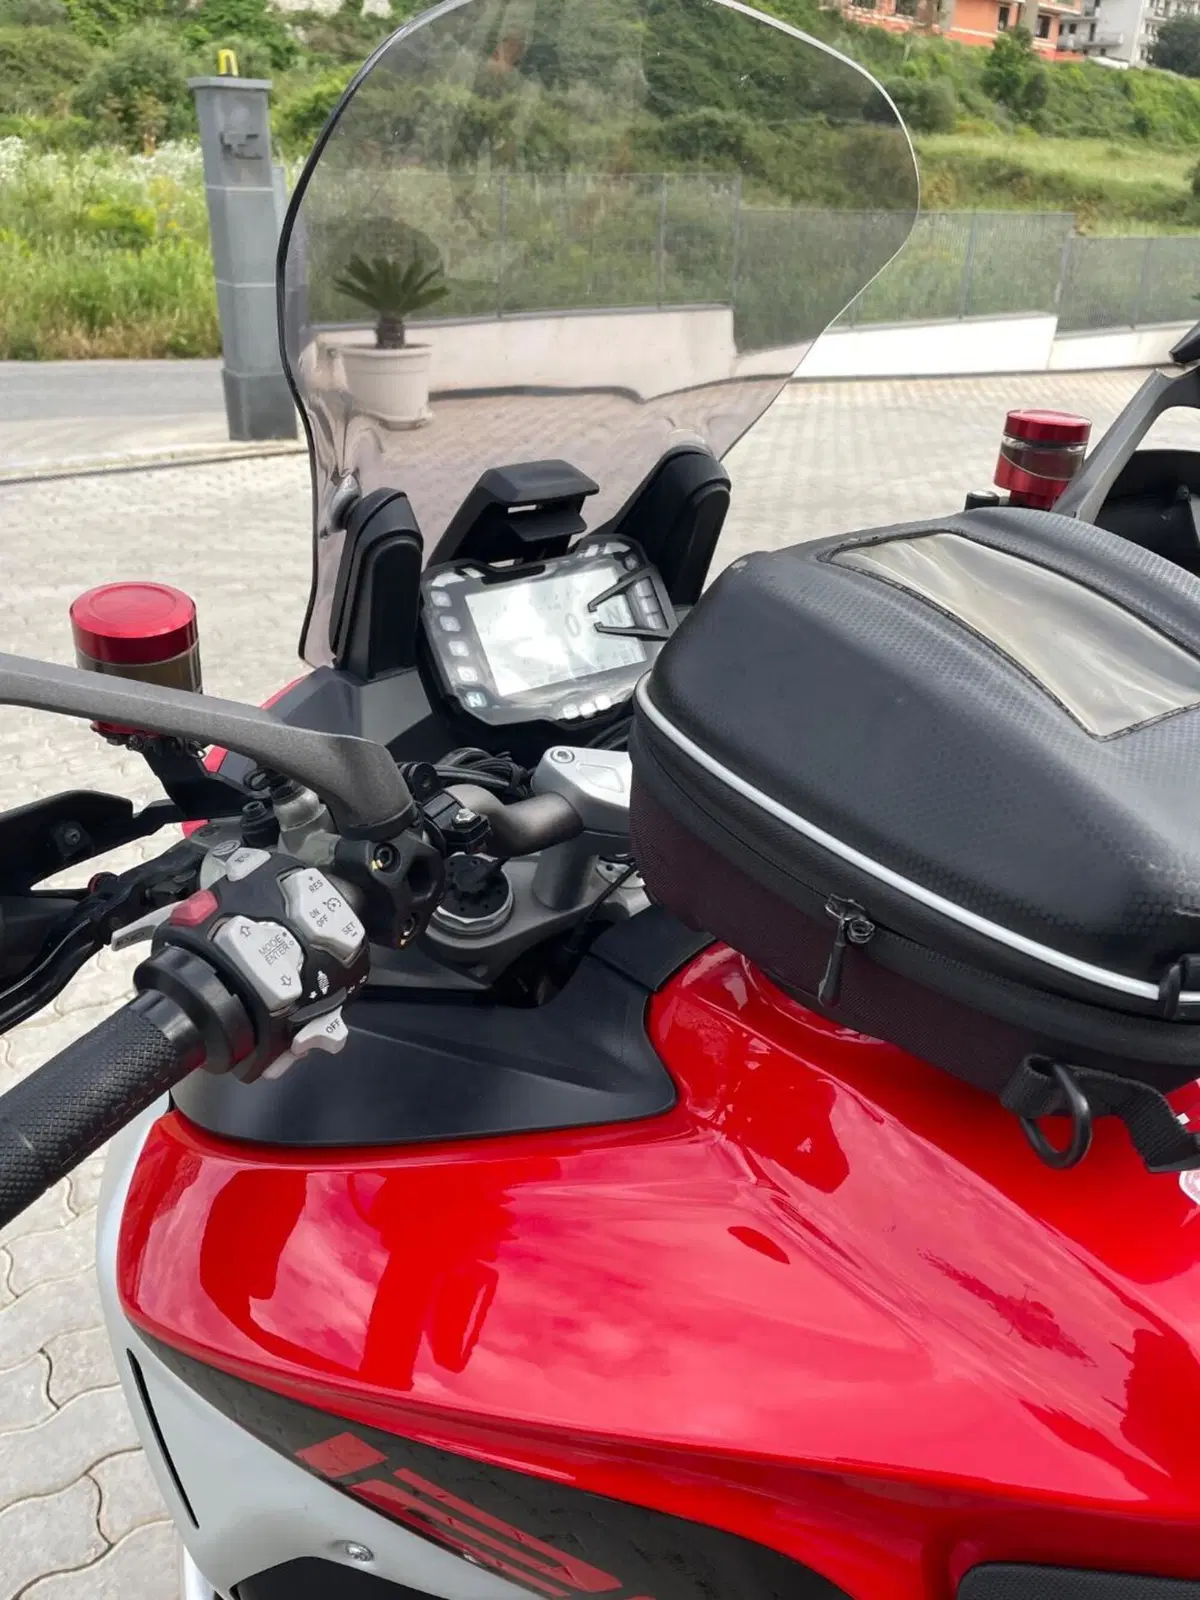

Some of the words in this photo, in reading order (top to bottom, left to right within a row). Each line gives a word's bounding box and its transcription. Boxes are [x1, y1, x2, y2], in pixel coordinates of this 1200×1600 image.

[468, 692, 483, 708] N
[308, 879, 324, 893] RES
[316, 914, 329, 928] OFF
[341, 921, 356, 936] SET
[258, 934, 282, 957] MODE
[265, 941, 290, 965] ENTER
[325, 1018, 341, 1034] OFF
